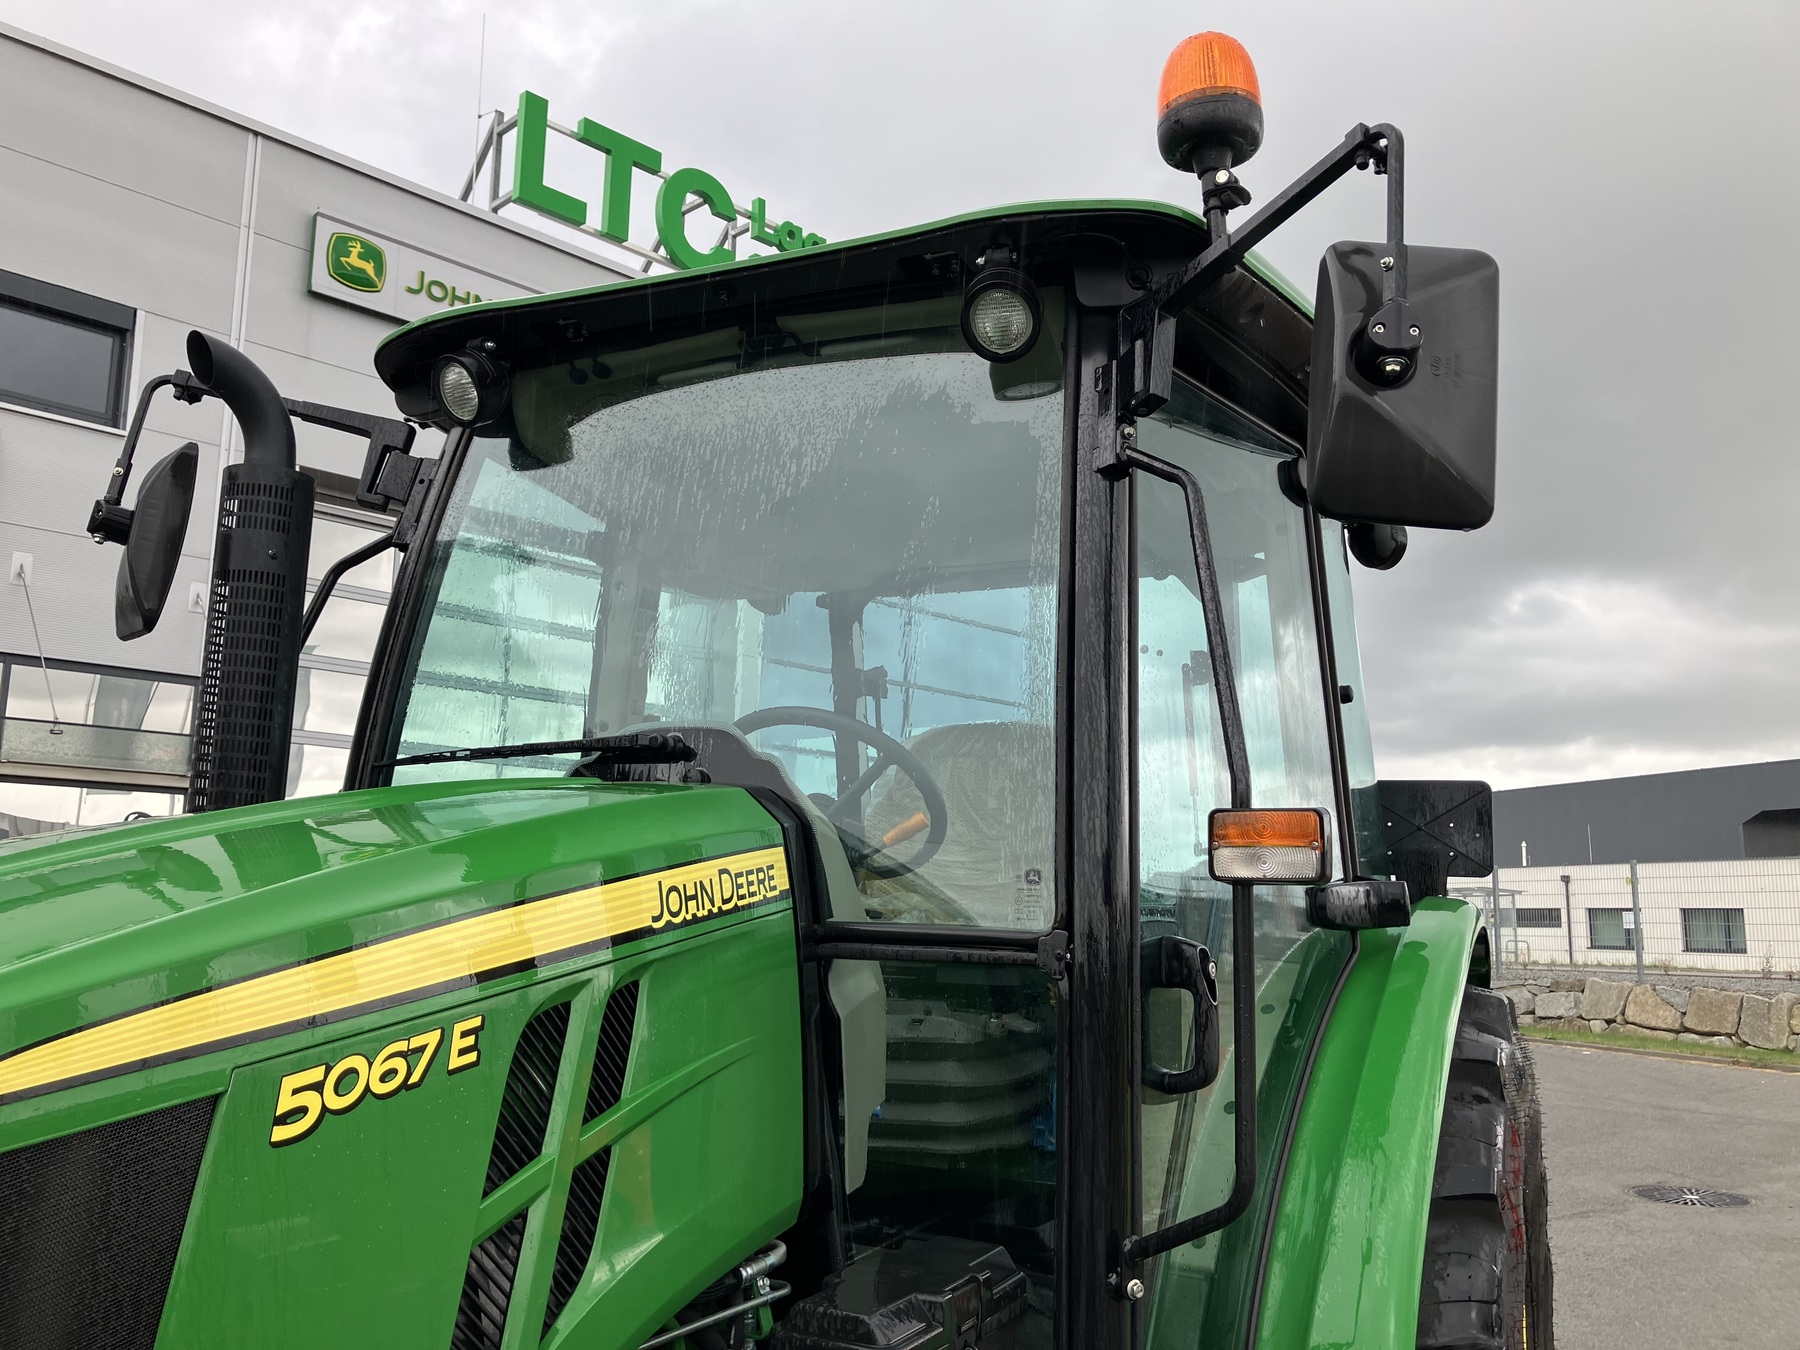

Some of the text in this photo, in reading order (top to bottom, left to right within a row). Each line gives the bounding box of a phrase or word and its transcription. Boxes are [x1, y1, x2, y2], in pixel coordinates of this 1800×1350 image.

[512, 90, 736, 270] LTC
[651, 863, 779, 925] JOHN DEERE
[269, 1014, 486, 1149] 5067 E
